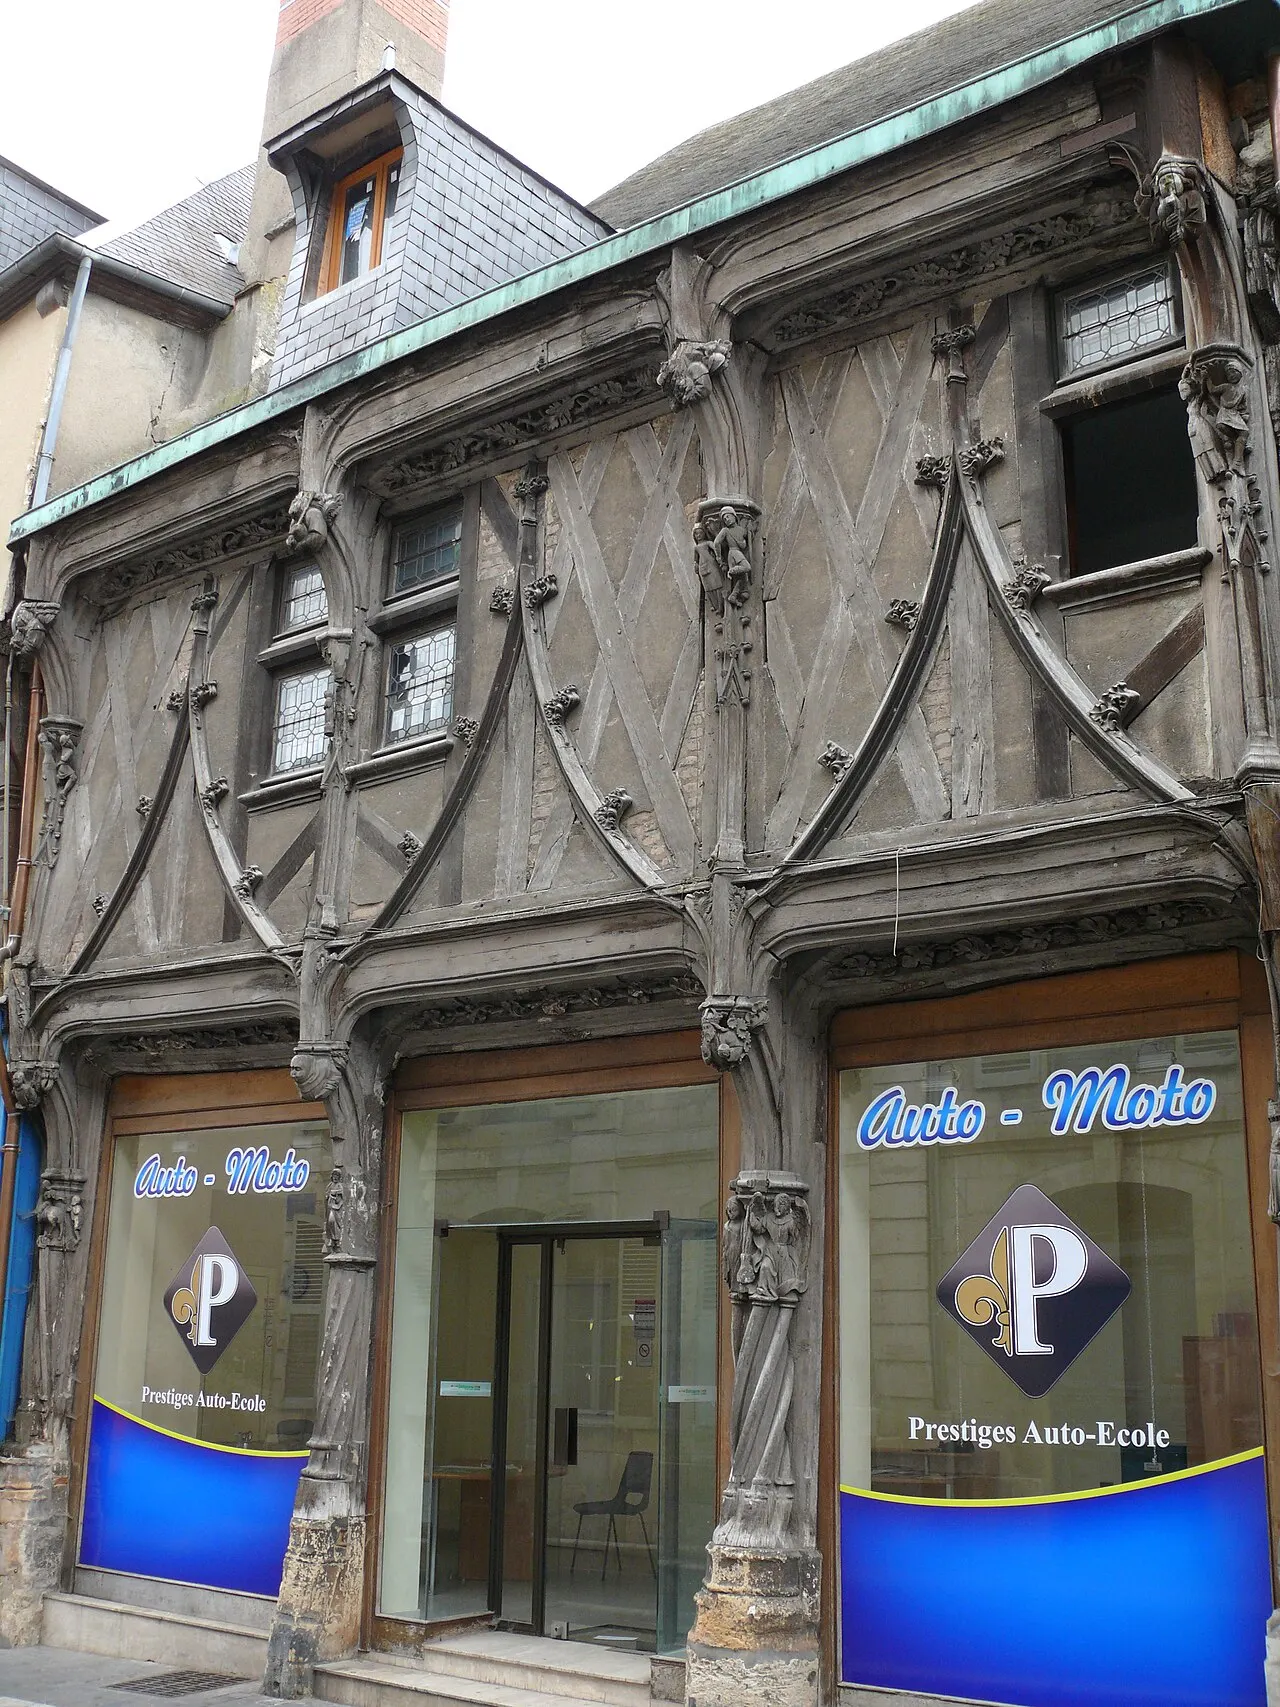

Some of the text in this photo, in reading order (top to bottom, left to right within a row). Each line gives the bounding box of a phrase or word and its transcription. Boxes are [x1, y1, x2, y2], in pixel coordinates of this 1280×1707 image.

[857, 1063, 1216, 1150] Auto - Moto
[134, 1154, 197, 1197] Auto
[225, 1146, 309, 1194] Moto
[198, 1254, 239, 1345] P
[1011, 1224, 1088, 1355] P
[142, 1386, 266, 1412] Prestiges Auto-Ecole
[908, 1416, 1170, 1448] Prestiges Auto-Ecole
